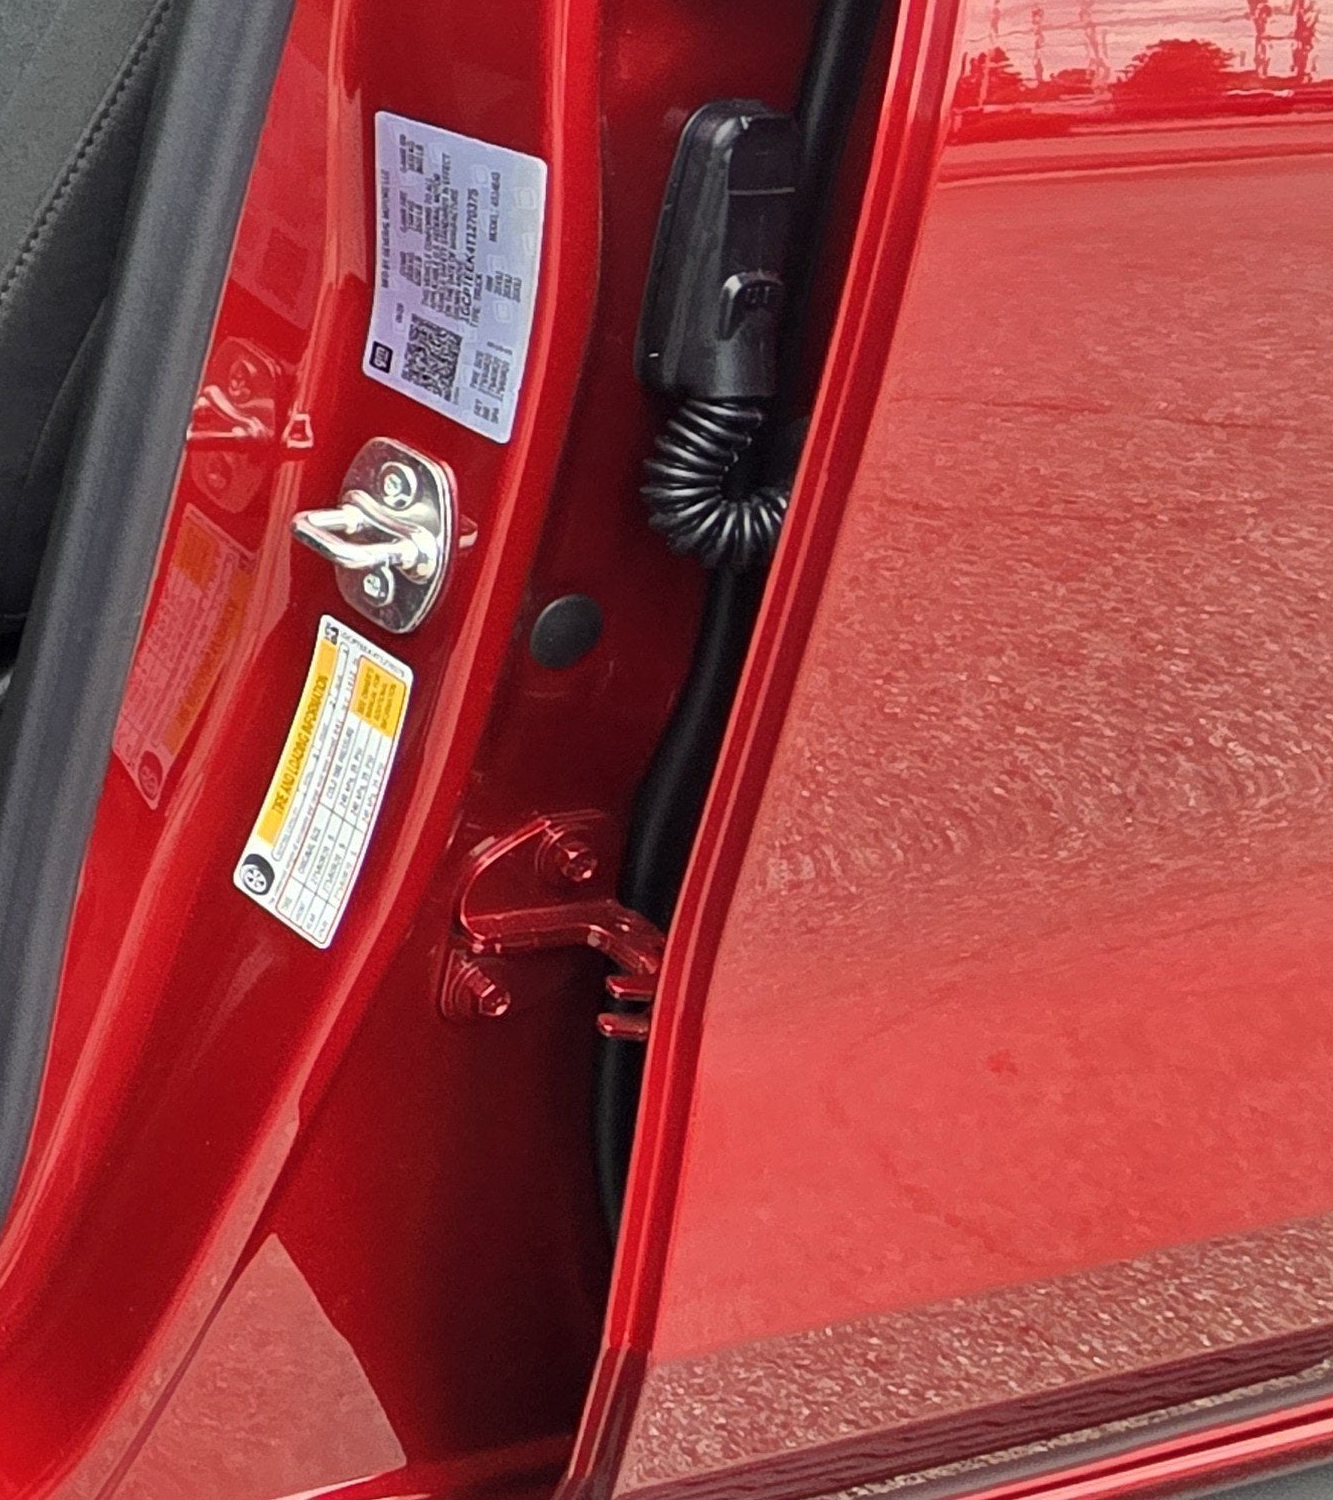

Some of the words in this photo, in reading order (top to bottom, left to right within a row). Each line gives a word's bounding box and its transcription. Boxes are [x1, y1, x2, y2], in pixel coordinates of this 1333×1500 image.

[271, 792, 289, 815] TIRE
[280, 773, 295, 795] AND
[288, 732, 310, 776] LOADING
[300, 675, 328, 735] INFORMATION
